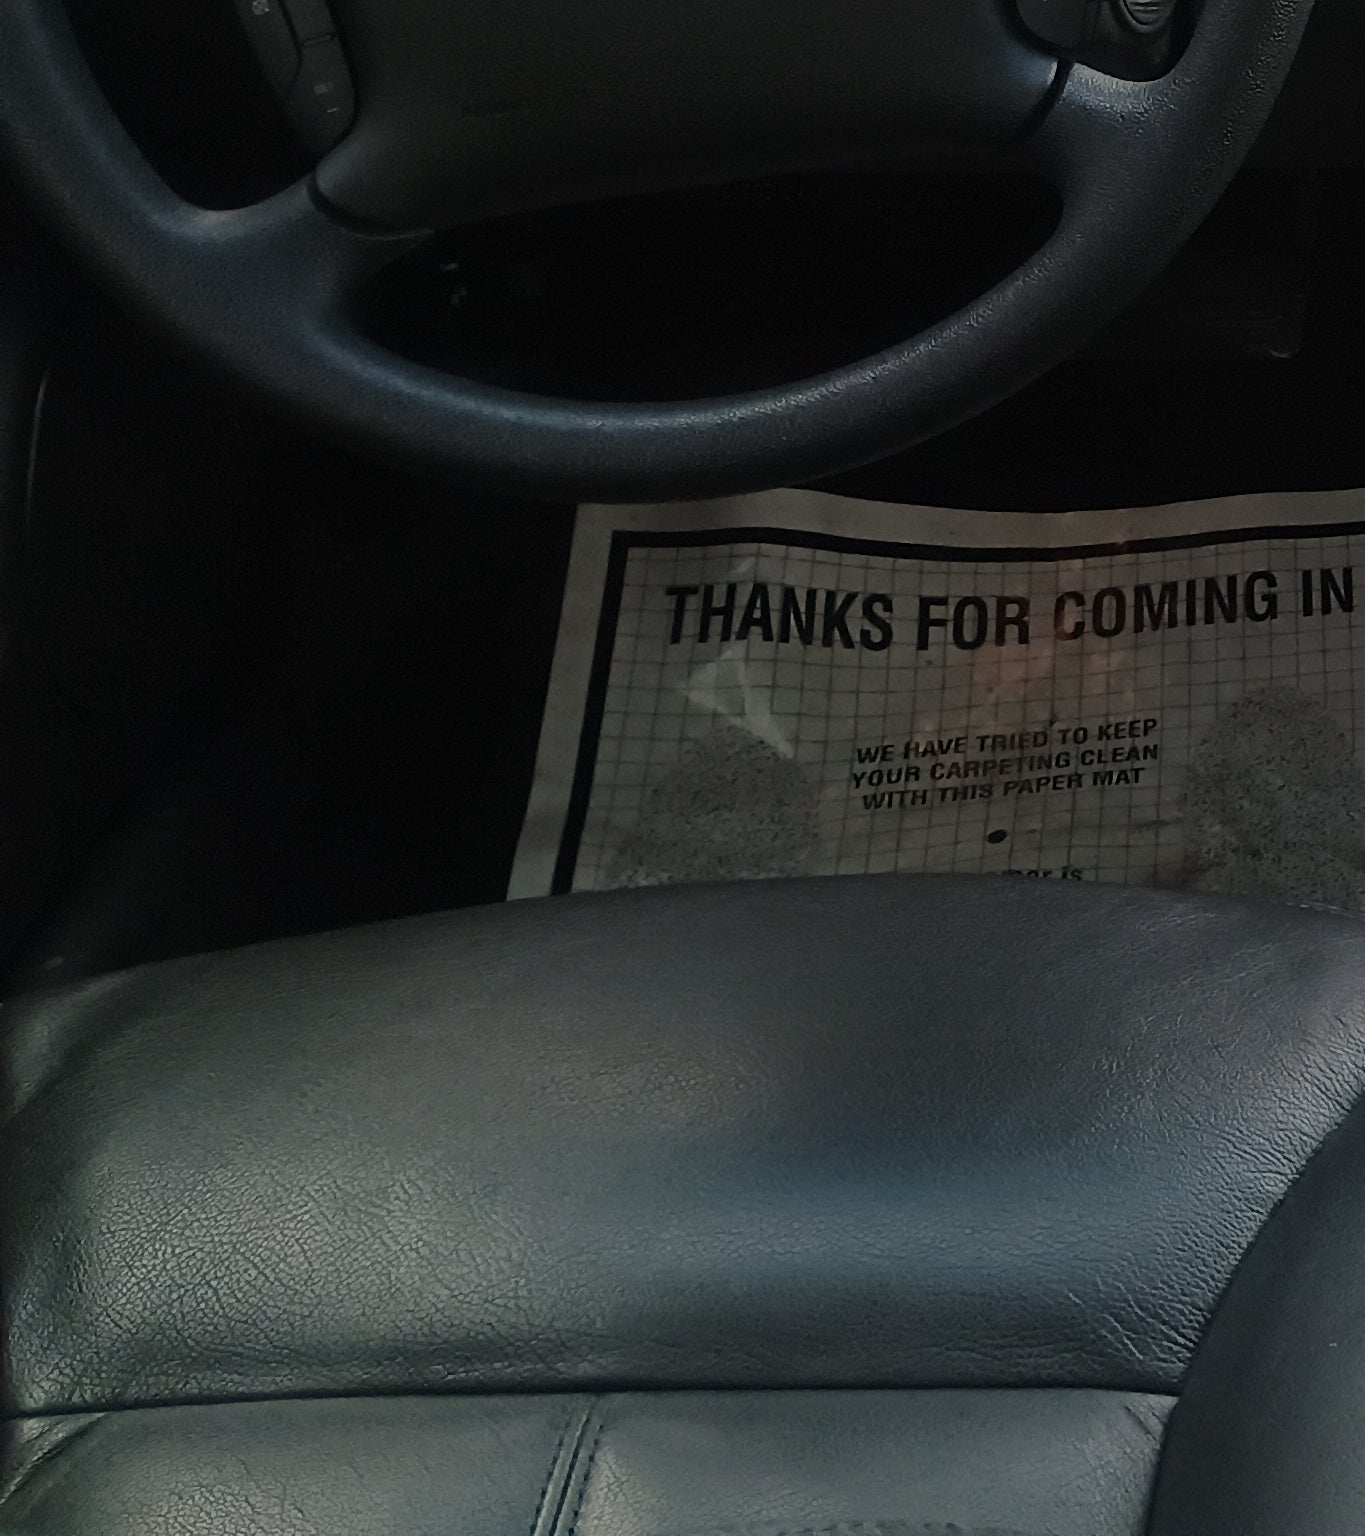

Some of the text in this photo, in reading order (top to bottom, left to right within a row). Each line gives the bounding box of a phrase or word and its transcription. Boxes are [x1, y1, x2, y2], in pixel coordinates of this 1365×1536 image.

[665, 565, 1355, 652] THANKS FOR COMING IN
[857, 717, 1159, 764] WE HAVE TRIED TO KEEP
[852, 743, 1158, 790] YOUR CARPETING CLEAN
[862, 766, 1146, 810] WITH THIS PAPER MAT
